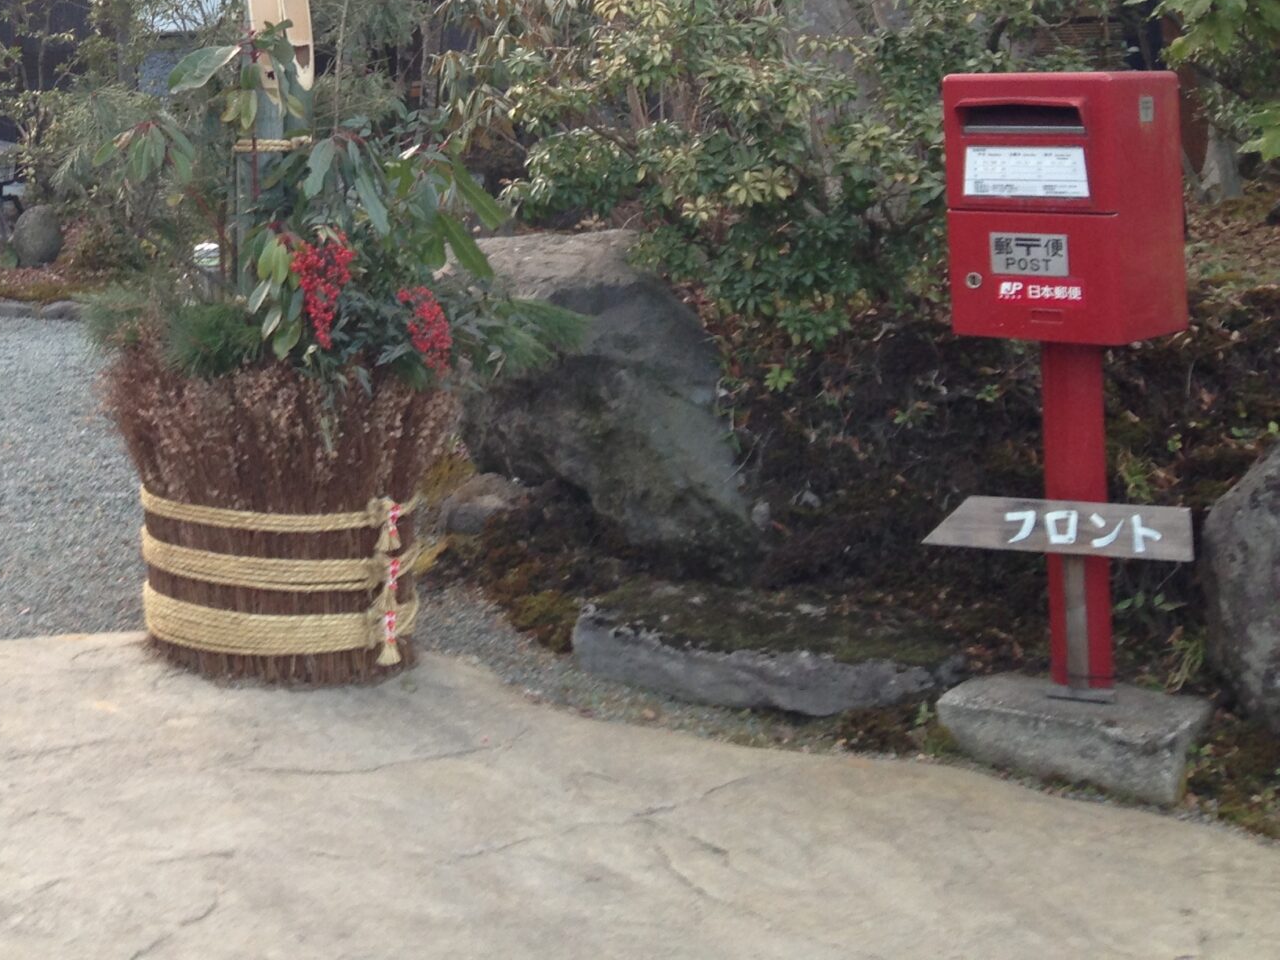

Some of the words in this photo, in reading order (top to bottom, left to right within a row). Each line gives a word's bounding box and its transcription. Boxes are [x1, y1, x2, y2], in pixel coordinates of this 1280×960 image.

[1005, 257, 1052, 272] POST
[1027, 284, 1082, 300] 日本郵便
[1004, 510, 1162, 553] フロント
